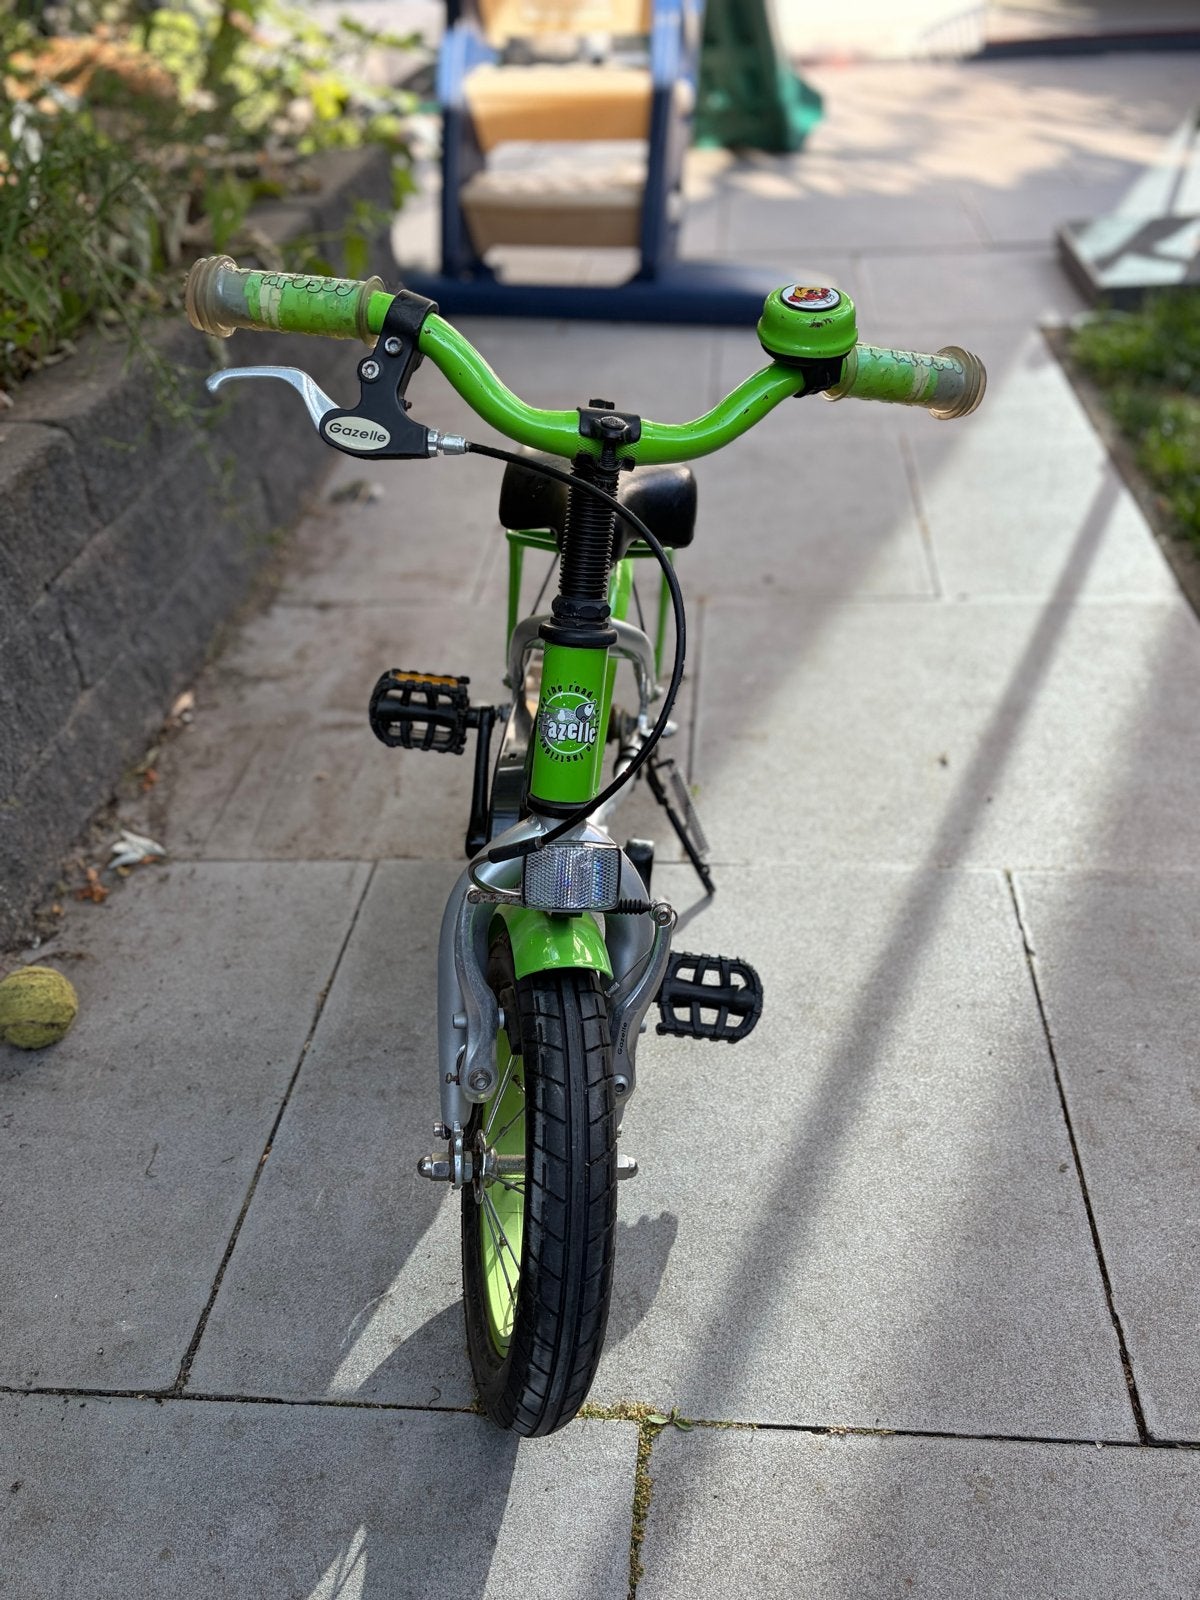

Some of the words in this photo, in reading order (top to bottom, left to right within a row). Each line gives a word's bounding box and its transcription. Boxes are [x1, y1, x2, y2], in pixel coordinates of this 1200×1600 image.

[329, 422, 387, 443] Gazelle
[568, 684, 593, 698] road
[617, 1022, 628, 1055] Gazelle
